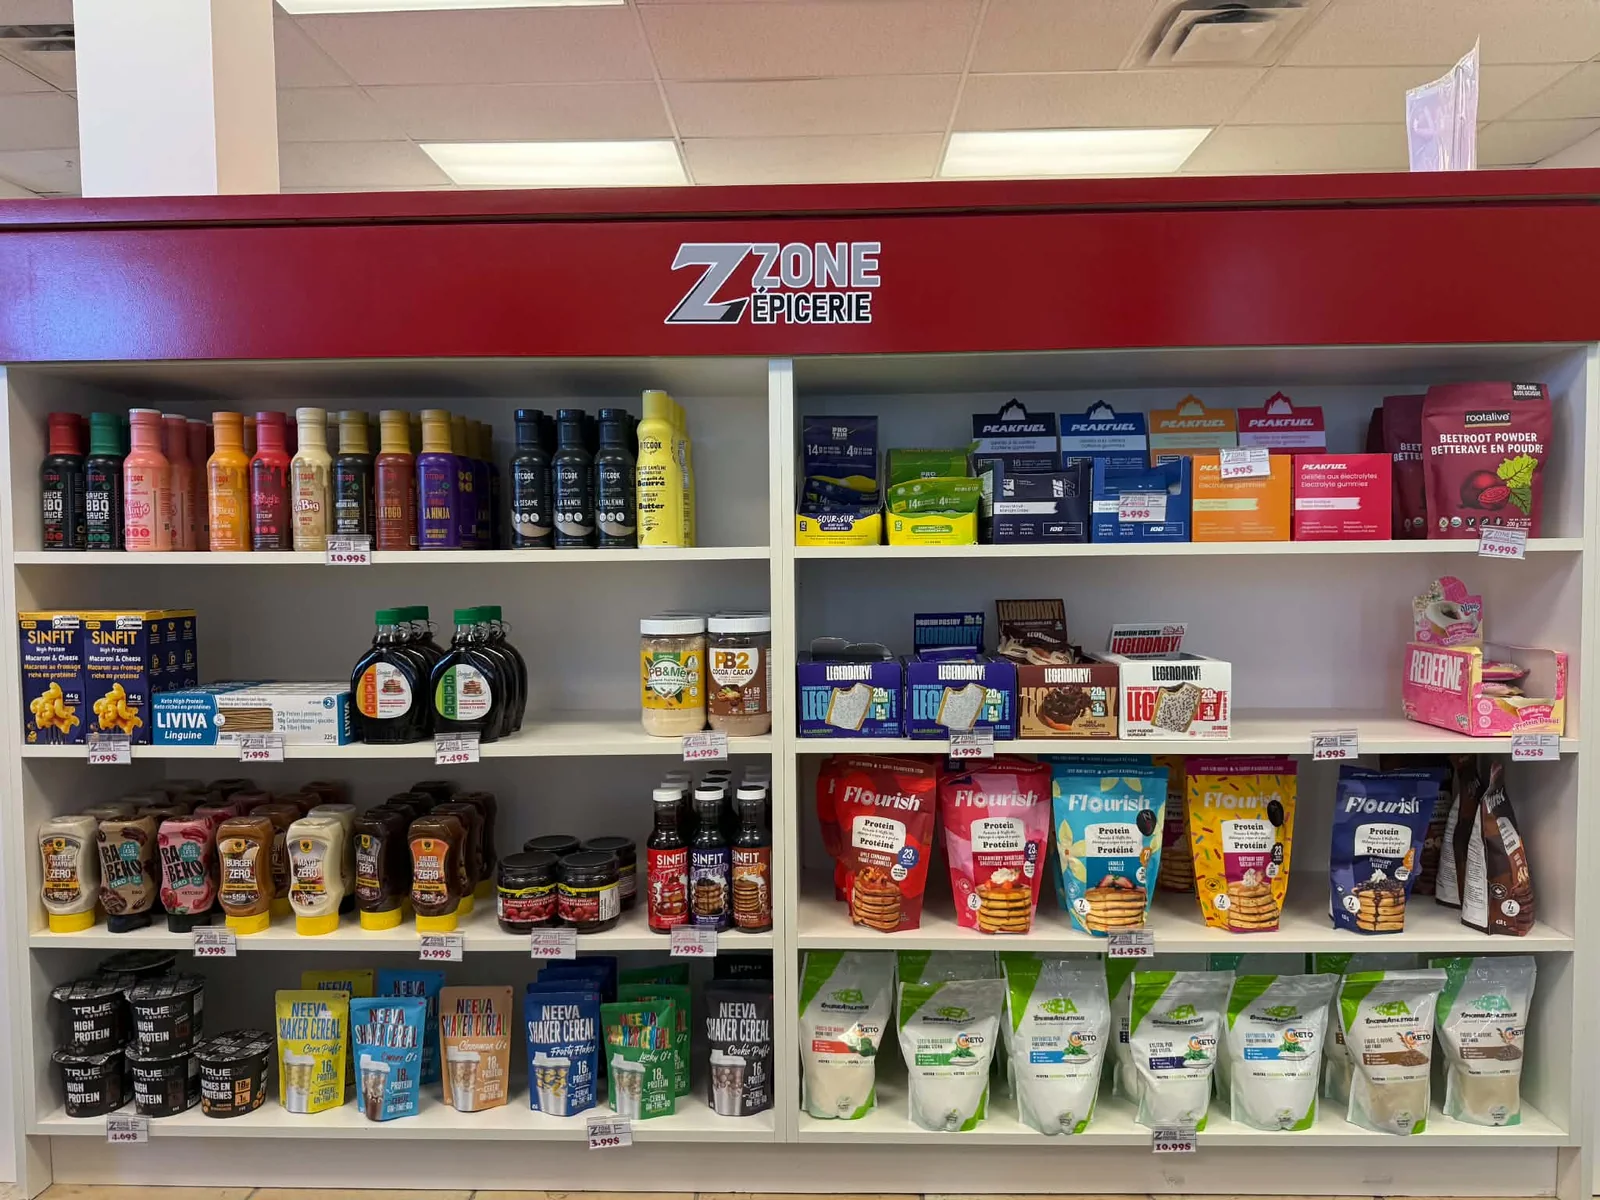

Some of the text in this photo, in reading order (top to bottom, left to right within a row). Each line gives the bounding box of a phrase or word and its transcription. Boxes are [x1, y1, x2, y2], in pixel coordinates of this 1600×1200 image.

[752, 243, 881, 288] ZONE
[752, 286, 872, 323] ÉPICERIE
[1466, 412, 1510, 421] rootalive
[982, 424, 1046, 432] PEAKFUEL
[1071, 424, 1136, 432] PEAKFUEL
[1160, 420, 1226, 428] PEAKFUEL
[1249, 418, 1314, 427] PEAKFUEL
[1440, 433, 1537, 443] BEETROOT POWDER
[1431, 444, 1543, 455] BETTERAVE EN POUDRE
[1223, 465, 1253, 475] 3.99$
[1340, 472, 1378, 480] électrolytes
[1301, 481, 1336, 489] Electrolyte
[86, 500, 110, 511] BBQ
[432, 507, 450, 519] NINJA
[1120, 510, 1149, 518] 3.99$
[1482, 544, 1518, 554] 19.99$
[330, 554, 366, 563] 10.99$
[28, 631, 74, 644] SINFIT
[92, 631, 137, 645] SINFIT
[1112, 636, 1179, 654] LEGENDARY
[715, 652, 749, 669] PB2
[826, 665, 870, 680] LEGENDARY
[938, 664, 982, 680] LEGENDARY
[1045, 668, 1088, 683] LEGENDARY
[1152, 666, 1199, 681] LEGENDARY
[1410, 649, 1464, 691] REDEFINE
[873, 688, 888, 697] 20g
[986, 689, 1001, 698] 20g
[157, 712, 207, 729] LIVIVA
[164, 731, 202, 740] Linguine
[686, 749, 719, 758] 14.99$
[952, 748, 981, 756] 4.99$
[1316, 749, 1346, 758] 4.99$
[1515, 748, 1543, 757] 6.25$
[91, 754, 117, 762] 7.99$
[440, 754, 469, 762] 7.49$
[844, 786, 921, 811] Flourish
[955, 790, 1037, 808] Flourish
[1069, 794, 1150, 812] Flourish
[1345, 796, 1419, 814] Flourish
[865, 820, 894, 830] Protein
[860, 838, 894, 849] Protéiné
[101, 844, 121, 863] RA
[161, 845, 180, 864] RA
[657, 852, 687, 865] SINFIT
[693, 853, 723, 864] SINFIT
[50, 870, 70, 878] ZERO
[106, 860, 142, 881] BEKO
[168, 860, 204, 882] BEKO
[229, 869, 250, 878] ZERO
[297, 868, 317, 878] ZERO
[419, 870, 438, 879] ZERO
[111, 879, 126, 888] ZERO
[173, 880, 187, 889] ZERO
[423, 950, 451, 958] 9.99$
[72, 1003, 111, 1015] TRUE
[135, 1006, 169, 1015] TRUE
[292, 1002, 328, 1017] NEEVA
[457, 998, 492, 1014] NEEVA
[719, 1002, 756, 1019] NEEVA
[370, 1009, 406, 1024] NEEVA
[542, 1005, 580, 1021] NEEVA
[619, 1012, 658, 1027] NEEVA
[74, 1020, 94, 1031] HIGH
[138, 1021, 153, 1031] HIGH
[311, 1018, 341, 1040] CEREAL
[442, 1014, 507, 1037] SHAKER CEREAL
[528, 1018, 594, 1043] SHAKER CEREAL
[706, 1018, 770, 1042] SHAKER CEREAL
[75, 1028, 110, 1041] PROTEIN
[139, 1031, 169, 1042] PROTEIN
[355, 1025, 418, 1049] SHAKER CEREAL
[606, 1026, 672, 1050] SHAKER CEREAL
[638, 1051, 658, 1064] Lucky
[65, 1067, 100, 1076] TRUE
[132, 1067, 162, 1077] TRUE
[201, 1065, 231, 1076] TRUE
[67, 1082, 84, 1092] HIGH
[134, 1081, 147, 1093] HIGH
[648, 1078, 668, 1088] PROTEIN
[68, 1091, 100, 1102] PROTEIN
[135, 1092, 162, 1104] PROTEIN
[202, 1088, 232, 1099] PROTÉINES
[590, 1138, 619, 1147] 3.99$
